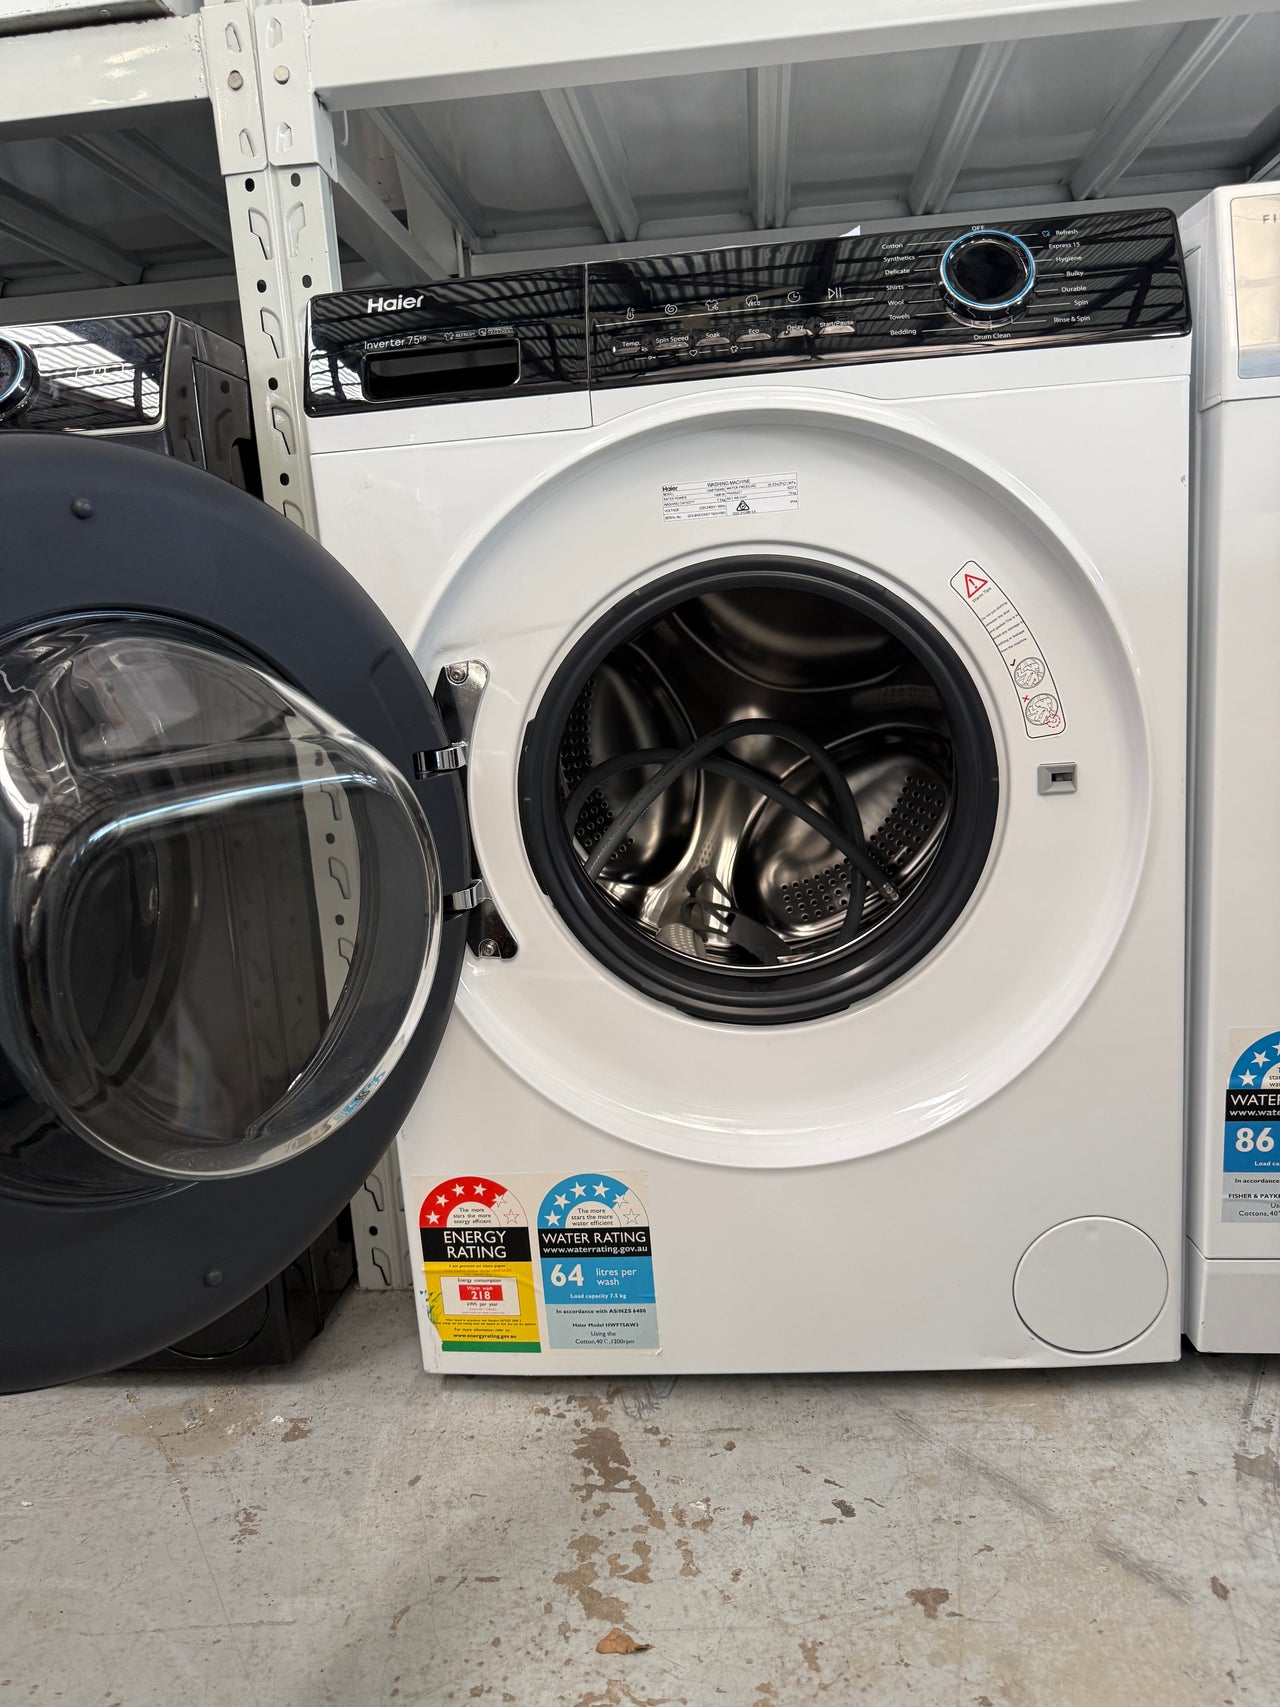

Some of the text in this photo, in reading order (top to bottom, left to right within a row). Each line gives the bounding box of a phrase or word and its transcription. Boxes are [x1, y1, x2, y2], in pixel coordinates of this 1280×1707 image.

[1049, 242, 1070, 250] Express
[883, 254, 915, 262] Synthetics
[1055, 255, 1082, 263] Hygiene
[368, 295, 424, 313] Haier
[786, 324, 804, 332] Delay
[819, 320, 854, 328] Start/Pause
[890, 328, 916, 336] Bedding
[364, 338, 406, 350] Inverter
[671, 335, 689, 344] Speed
[1235, 1127, 1274, 1152] 86
[444, 1231, 506, 1244] ENERGY
[542, 1232, 646, 1244] WATER RATING
[447, 1245, 506, 1258] RATING
[543, 1245, 648, 1254] www.waterrating.gov.au
[551, 1263, 637, 1287] 64 litres per
[597, 1278, 619, 1286] wash
[471, 1291, 491, 1300] 218
